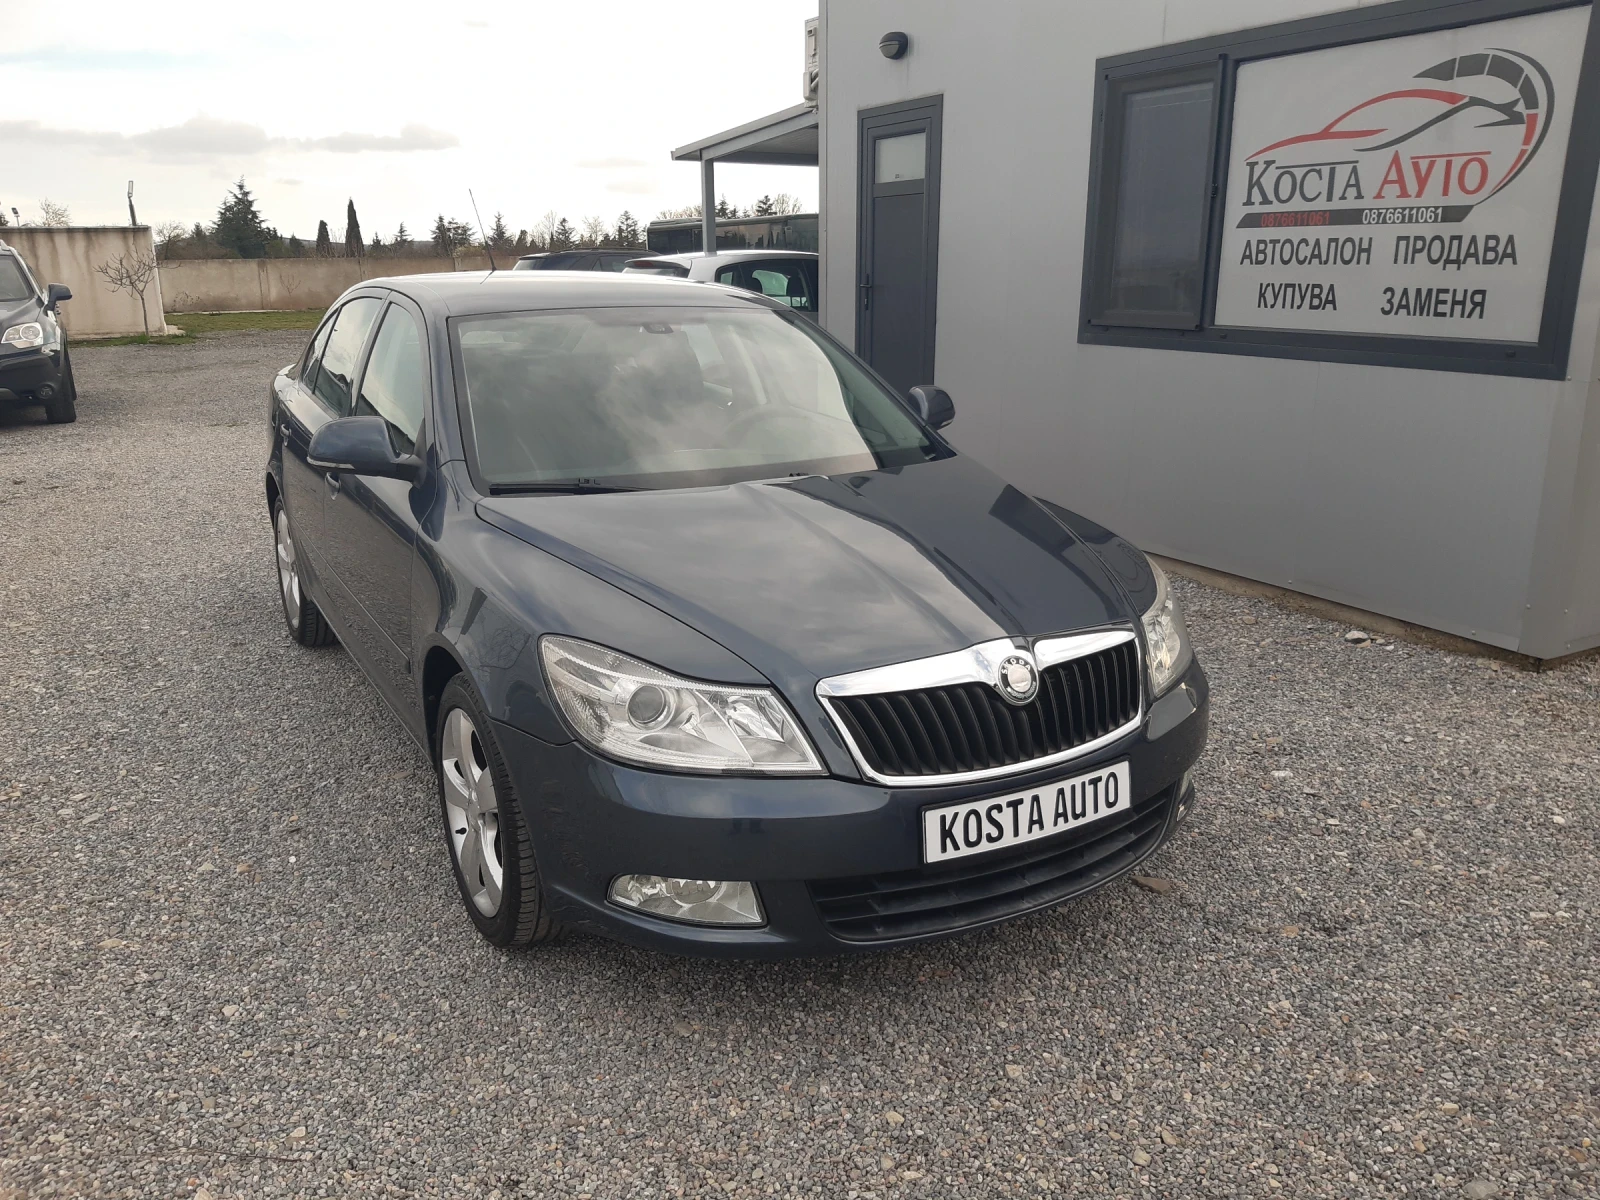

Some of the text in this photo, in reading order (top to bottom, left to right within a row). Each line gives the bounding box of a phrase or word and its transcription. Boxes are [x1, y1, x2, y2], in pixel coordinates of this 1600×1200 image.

[1260, 206, 1443, 228] 0876611061 0876611061
[1239, 234, 1518, 271] АВТОСАЛОН ПРОДАВА
[1257, 282, 1487, 319] КУПУВА ЗАМЕНЯ
[939, 771, 1119, 854] KOSTA AUTO
